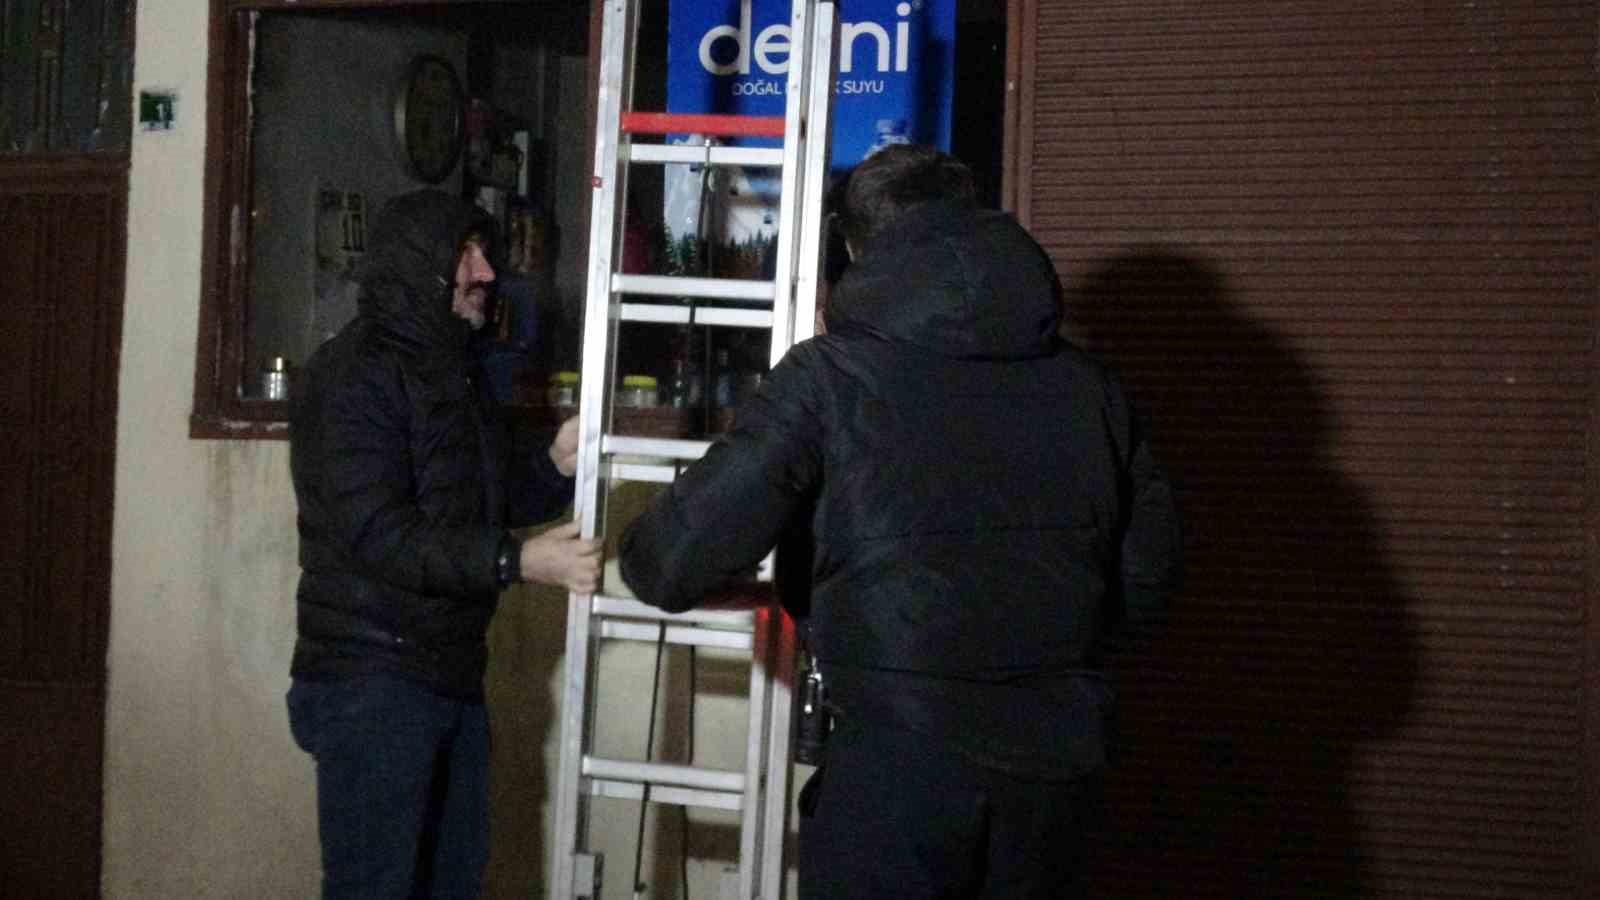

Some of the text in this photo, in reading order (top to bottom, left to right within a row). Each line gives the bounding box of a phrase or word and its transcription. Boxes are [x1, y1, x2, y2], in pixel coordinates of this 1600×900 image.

[698, 0, 911, 75] deni
[732, 79, 782, 96] DOĞAL
[843, 79, 885, 95] SUYU
